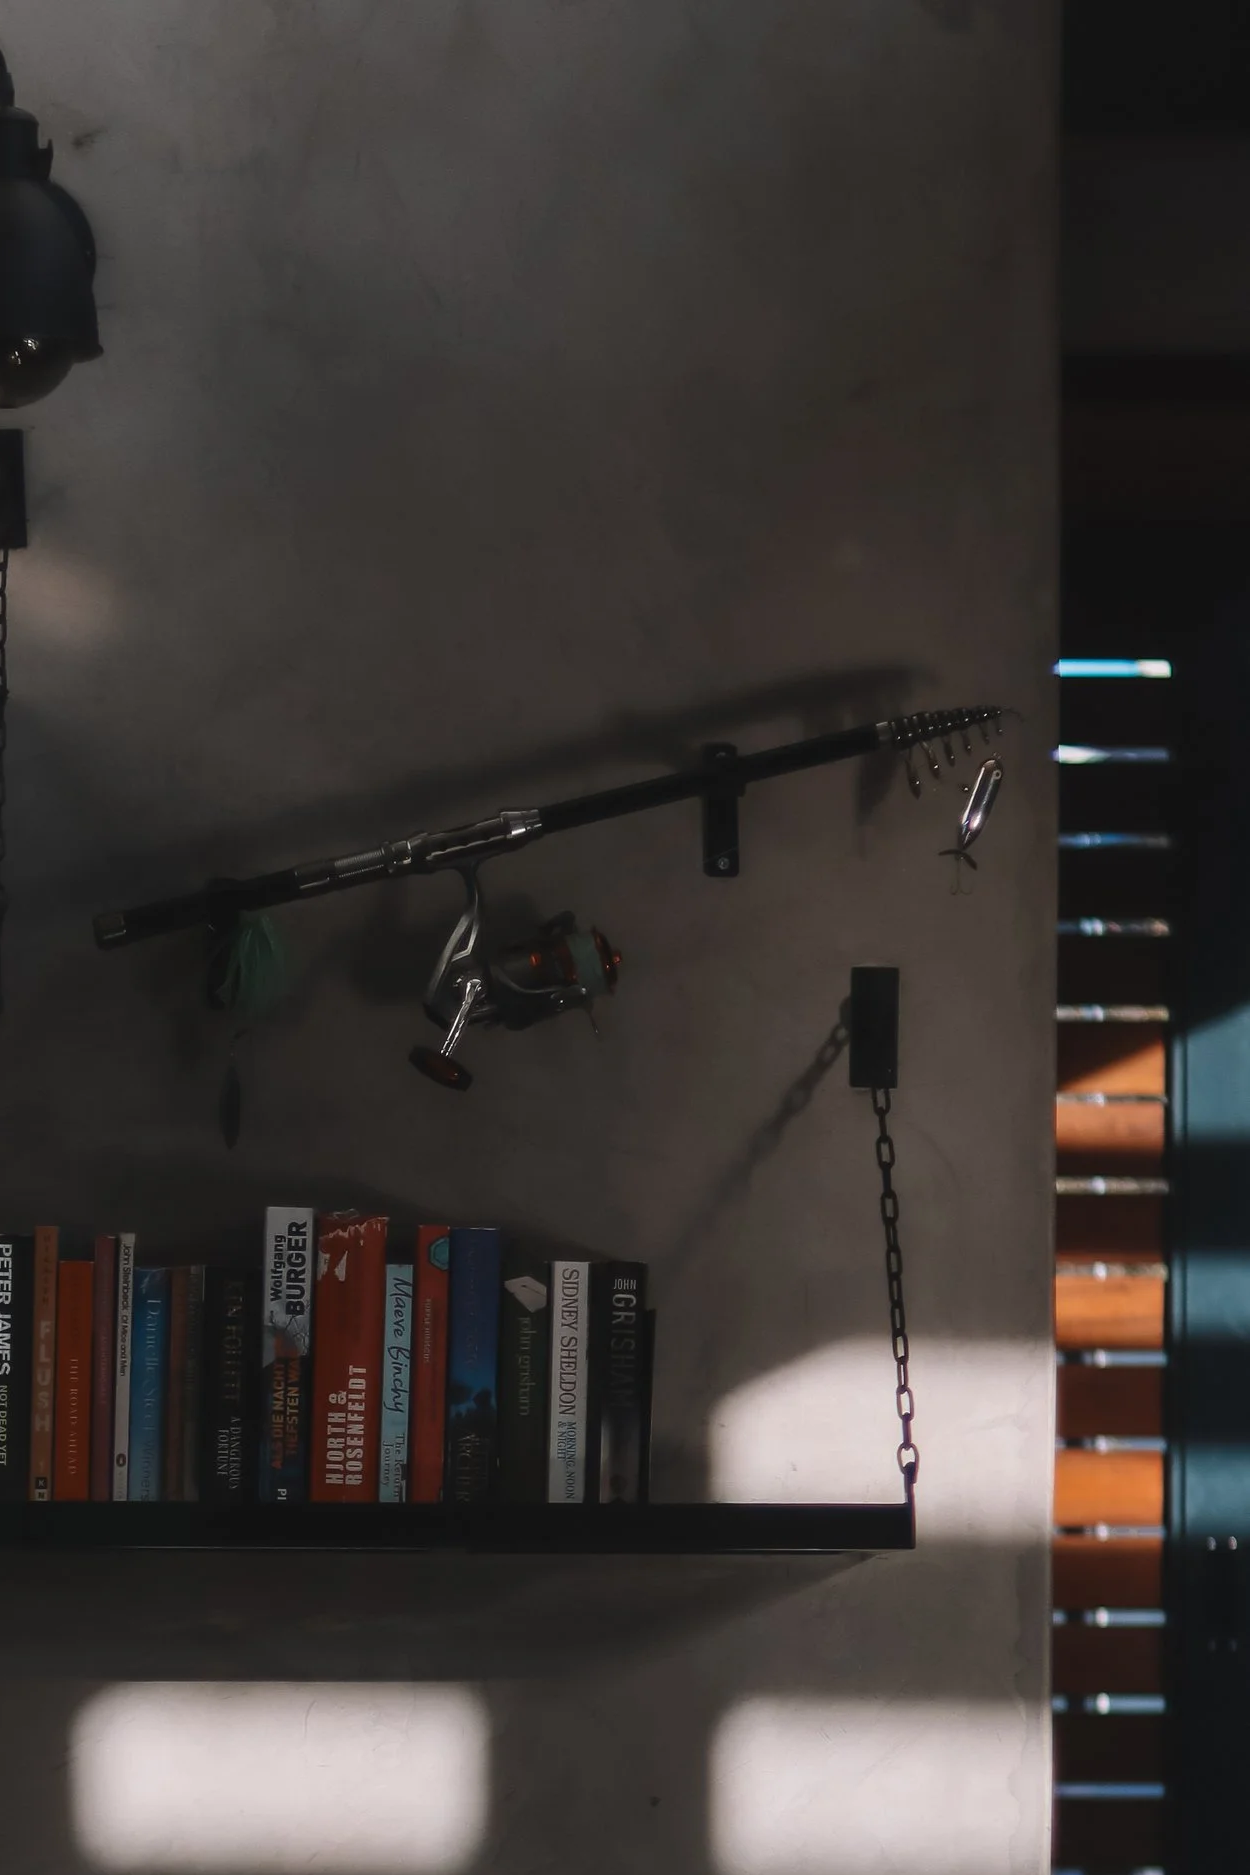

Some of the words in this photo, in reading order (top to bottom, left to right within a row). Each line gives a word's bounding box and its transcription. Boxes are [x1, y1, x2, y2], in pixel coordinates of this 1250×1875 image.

[123, 1245, 131, 1265] John
[269, 1235, 286, 1302] Wolfgang
[285, 1221, 307, 1316] BURGER
[121, 1266, 130, 1312] Steinbeck
[389, 1277, 414, 1339] Maeve
[561, 1268, 579, 1331] SIDNEY
[613, 1278, 637, 1291] JOHN
[520, 1317, 538, 1350] john
[610, 1293, 637, 1407] GRISHAM
[34, 1320, 54, 1432] FLUSH
[119, 1361, 127, 1377] Men
[272, 1363, 286, 1411] NACHT
[286, 1358, 302, 1384] WA
[383, 1346, 411, 1414] Binchy
[517, 1353, 537, 1416] grisham
[559, 1335, 579, 1416] SHELDON
[285, 1386, 300, 1456] TIEFSTEN
[328, 1390, 348, 1406] &
[272, 1413, 284, 1441] DIE
[325, 1412, 347, 1485] HJORTH
[344, 1365, 367, 1486] ROSENFELDT
[394, 1433, 407, 1453] The
[557, 1431, 567, 1461] NIGHT
[216, 1428, 230, 1477] FORTUNE
[228, 1426, 242, 1490] DANGEROUS
[381, 1442, 393, 1487] Journey
[565, 1471, 576, 1499] NOON
